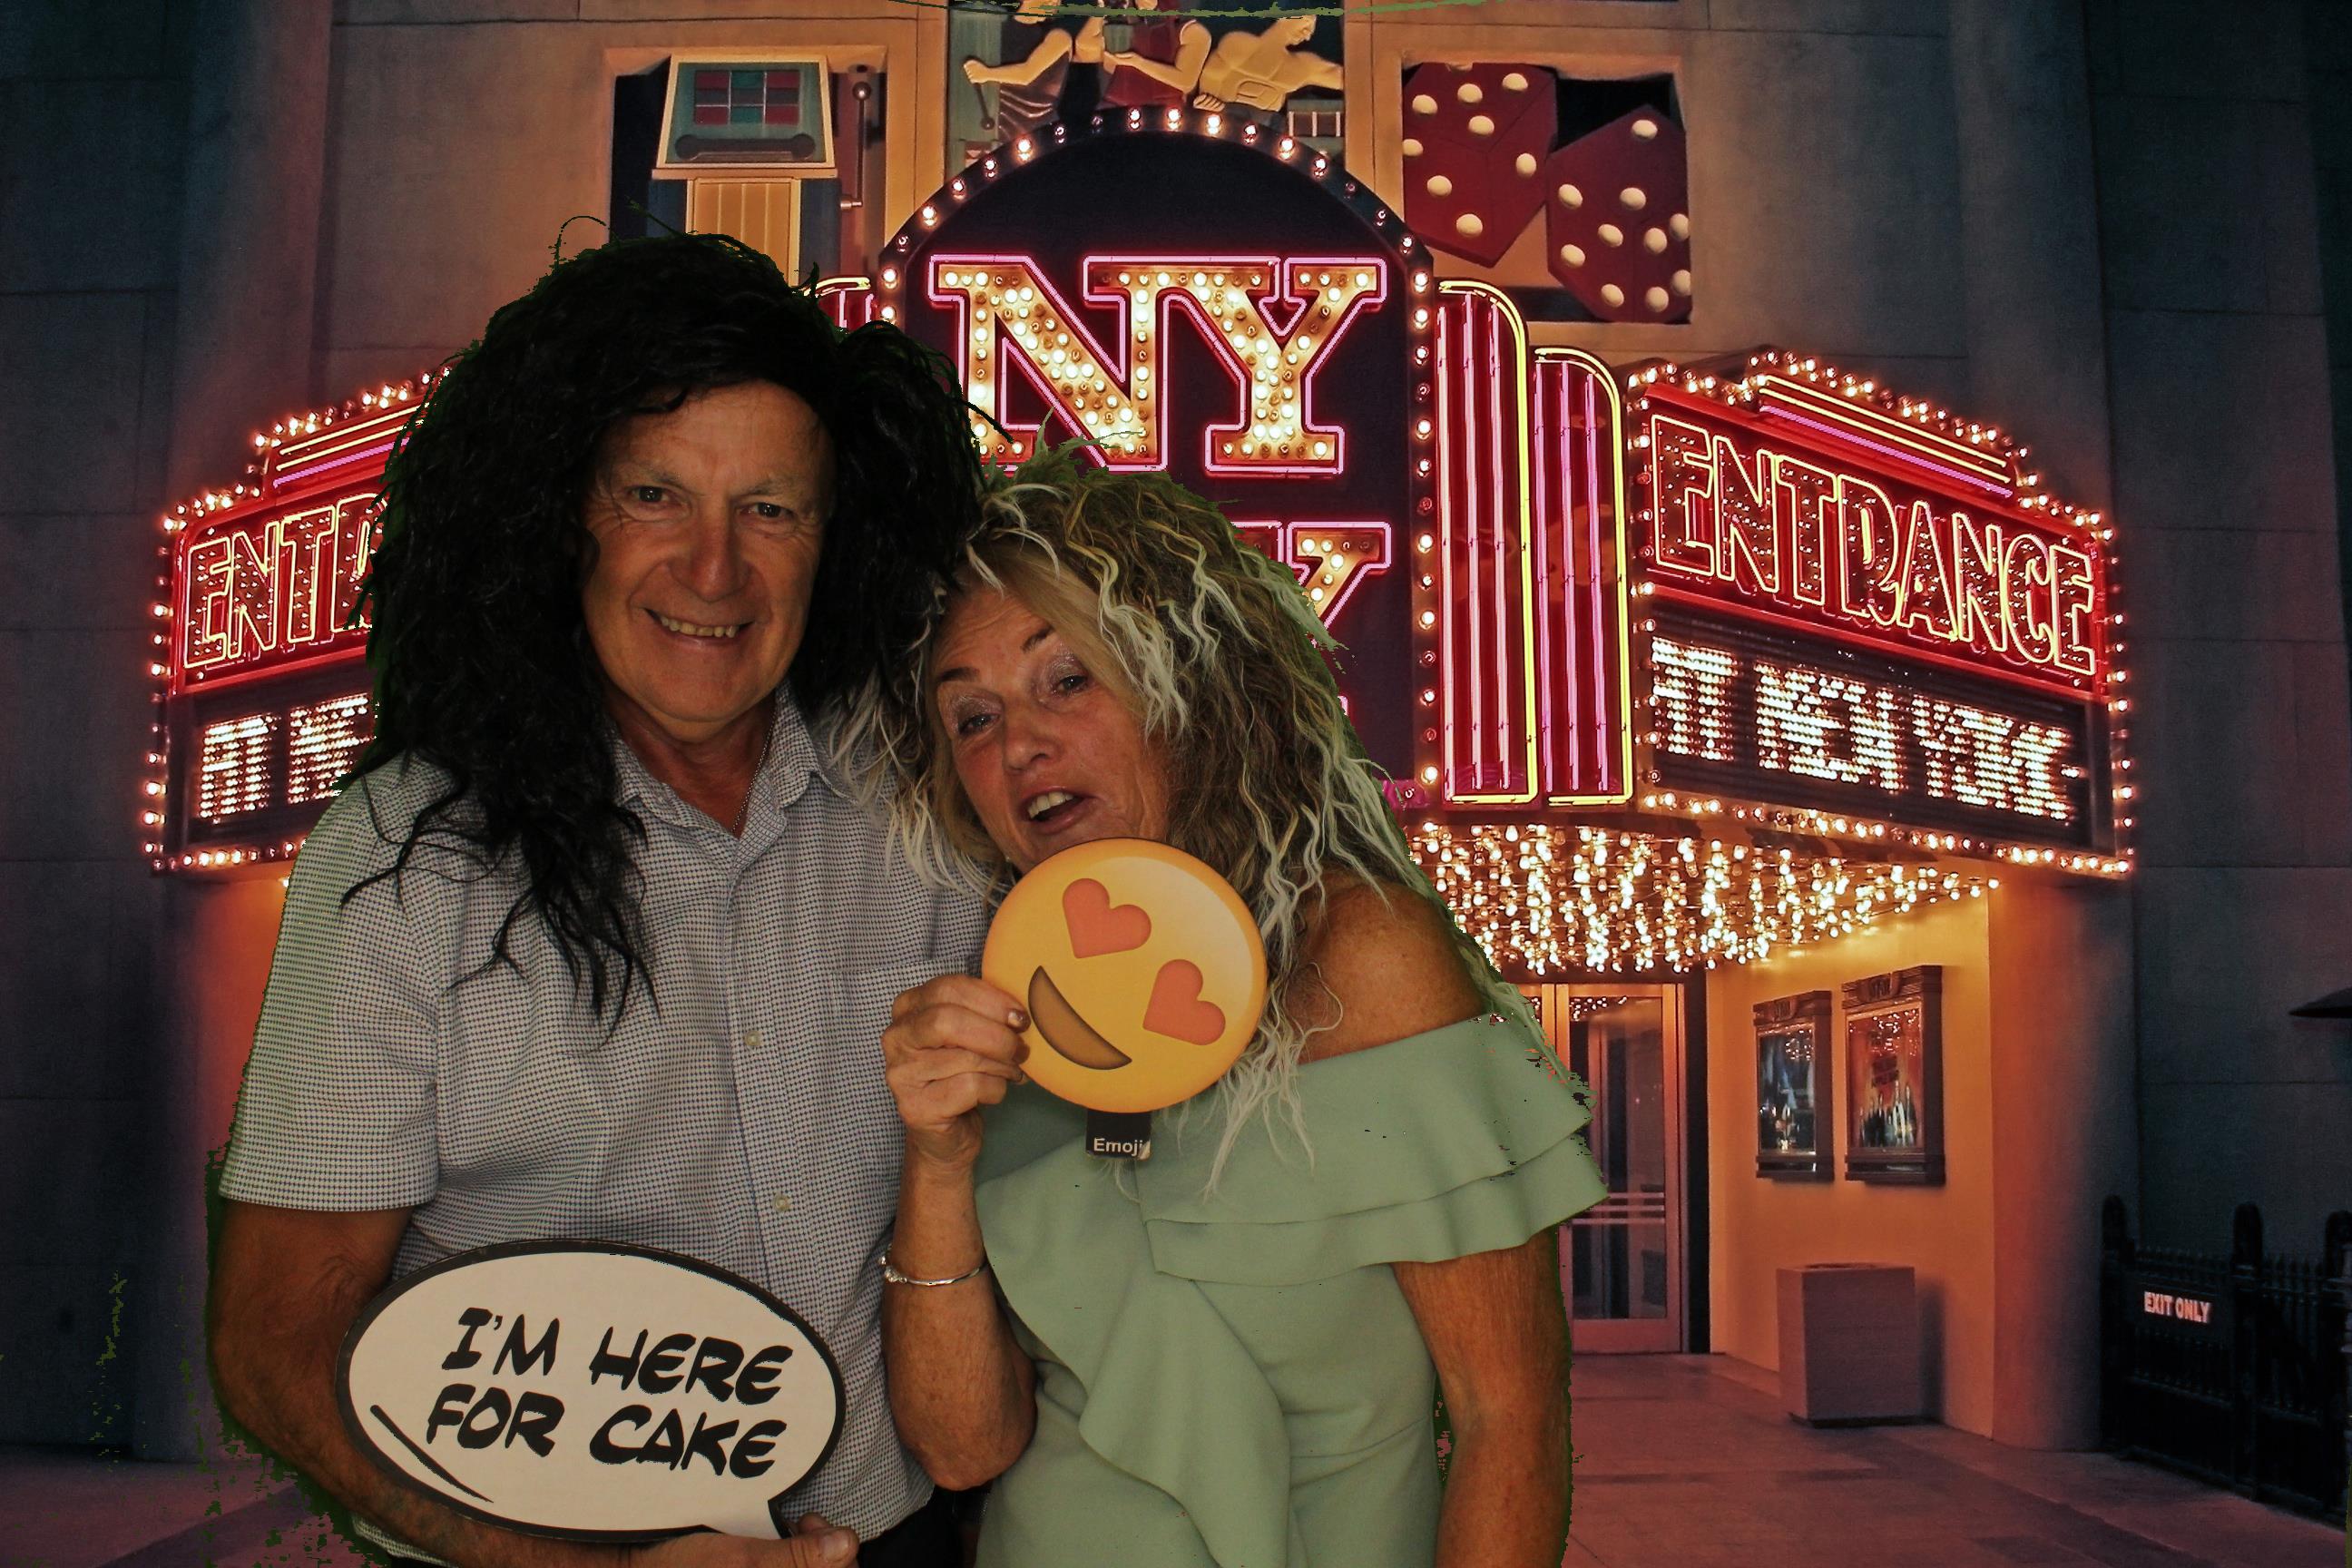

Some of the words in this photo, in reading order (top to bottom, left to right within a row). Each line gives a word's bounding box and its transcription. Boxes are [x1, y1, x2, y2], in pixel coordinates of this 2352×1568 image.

[928, 254, 1387, 475] NY
[1651, 414, 2097, 676] ENTRANCE
[442, 1307, 560, 1377] I'M
[588, 1327, 793, 1405] HERE
[2144, 1290, 2174, 1316] EXIT
[2175, 1297, 2212, 1324] ONLY
[426, 1384, 564, 1457] FOR
[589, 1404, 787, 1479] CAKE
